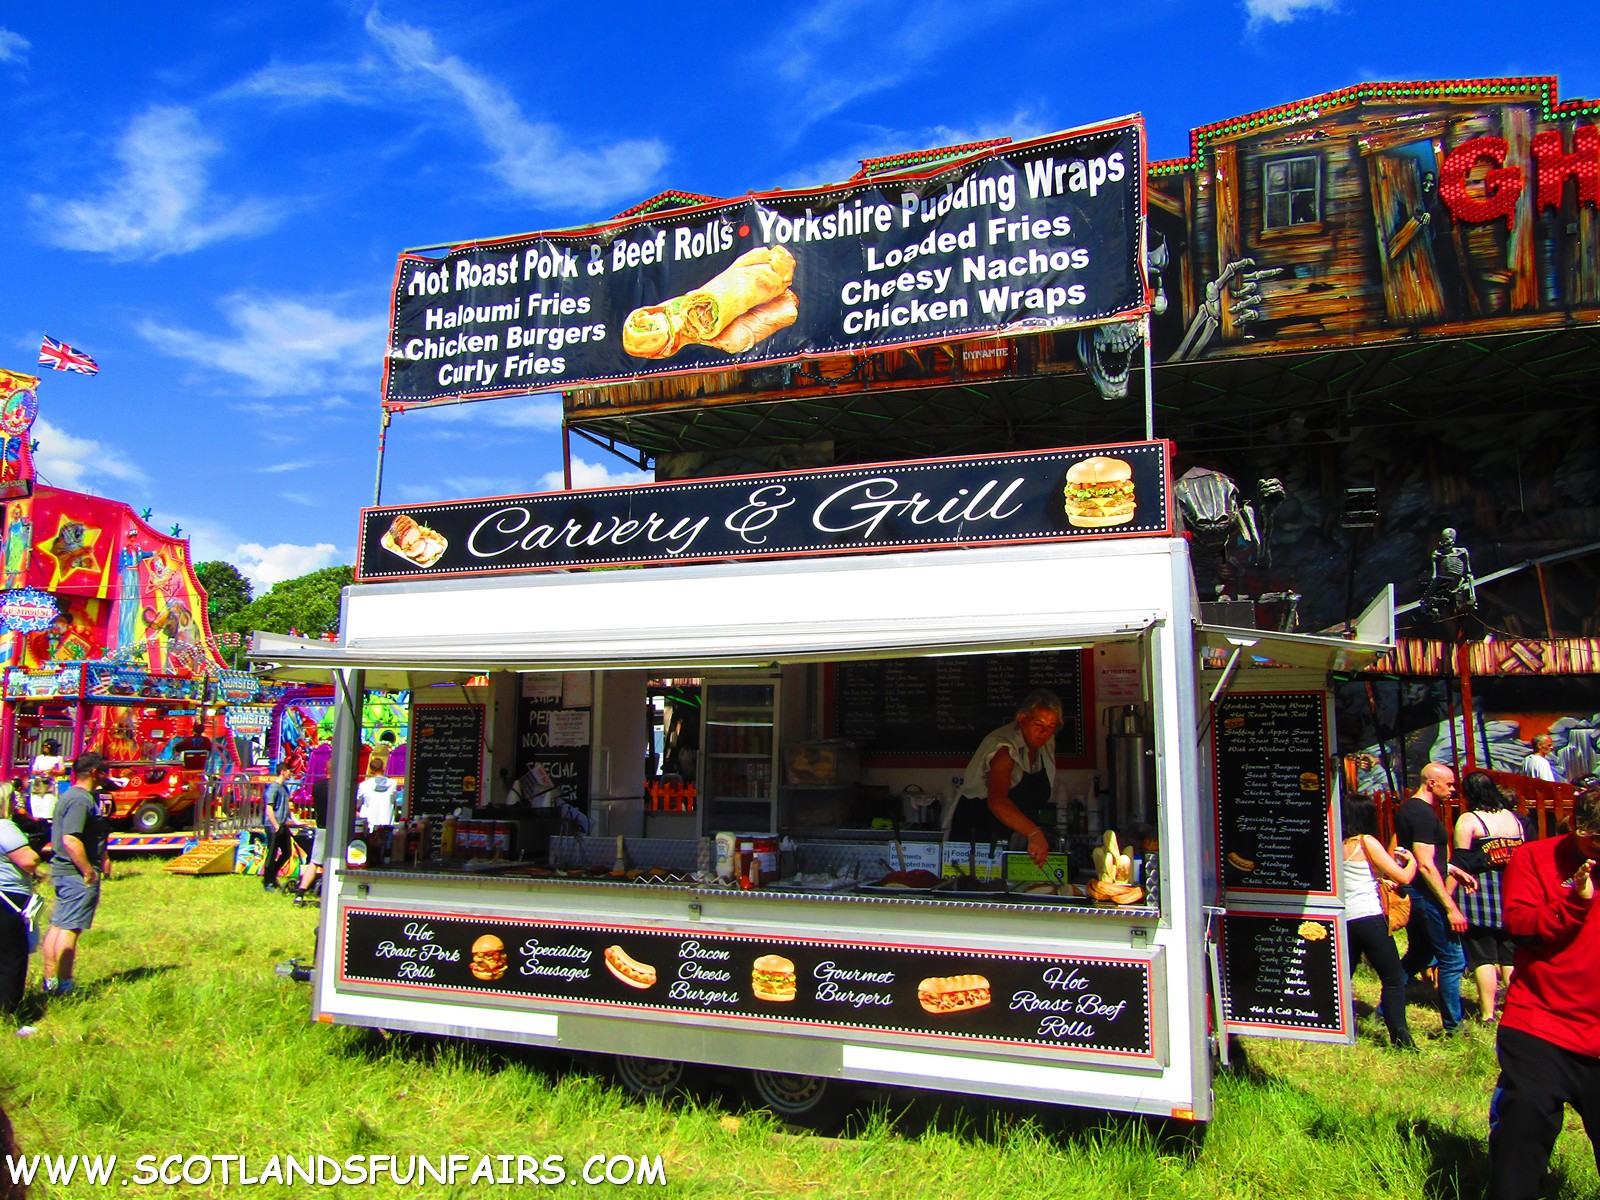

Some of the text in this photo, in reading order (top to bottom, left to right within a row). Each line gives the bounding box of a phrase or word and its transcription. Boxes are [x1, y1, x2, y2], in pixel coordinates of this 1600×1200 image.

[757, 151, 1126, 243] Yorkshire Pudding Wraps
[867, 214, 1072, 272] Loaded Fries
[407, 222, 734, 297] Hot Roast Pork & Beef Rolls
[841, 246, 1090, 306] Cheesy Nachos
[425, 292, 592, 332] Haloumi Fries
[842, 283, 1087, 335] Chicken Wraps
[405, 322, 606, 362] Chicken Burgers
[963, 347, 1009, 361] DYNAMITE
[438, 353, 567, 387] Curly Fries
[467, 477, 1026, 557] Carvery & Grill
[222, 679, 257, 690] MONSTER
[229, 713, 271, 725] MONSTER
[1244, 771, 1298, 780] Steak Burgers
[1273, 763, 1300, 771] Burgers
[1274, 790, 1301, 798] Burgers
[1284, 799, 1312, 807] Burgers
[951, 850, 970, 858] Food
[1280, 870, 1298, 878] Dogs
[404, 922, 435, 942] Hot
[1268, 925, 1289, 934] Chips
[376, 941, 461, 963] Roast Pork
[519, 938, 593, 963] Speciality
[678, 940, 731, 962] Bacon
[397, 960, 437, 980] Rolls
[519, 957, 592, 982] Sausages
[677, 961, 731, 983] Cheese
[813, 961, 895, 985] Gourmet
[1042, 967, 1090, 992] Hot
[668, 981, 740, 1006] Burgers
[815, 982, 894, 1009] Burgers
[1284, 987, 1295, 995] the
[1296, 988, 1311, 996] Cob
[1009, 990, 1128, 1022] Roast Beef
[1250, 1006, 1319, 1018] Hot & Cold Drinks
[1037, 1016, 1095, 1039] Rolls
